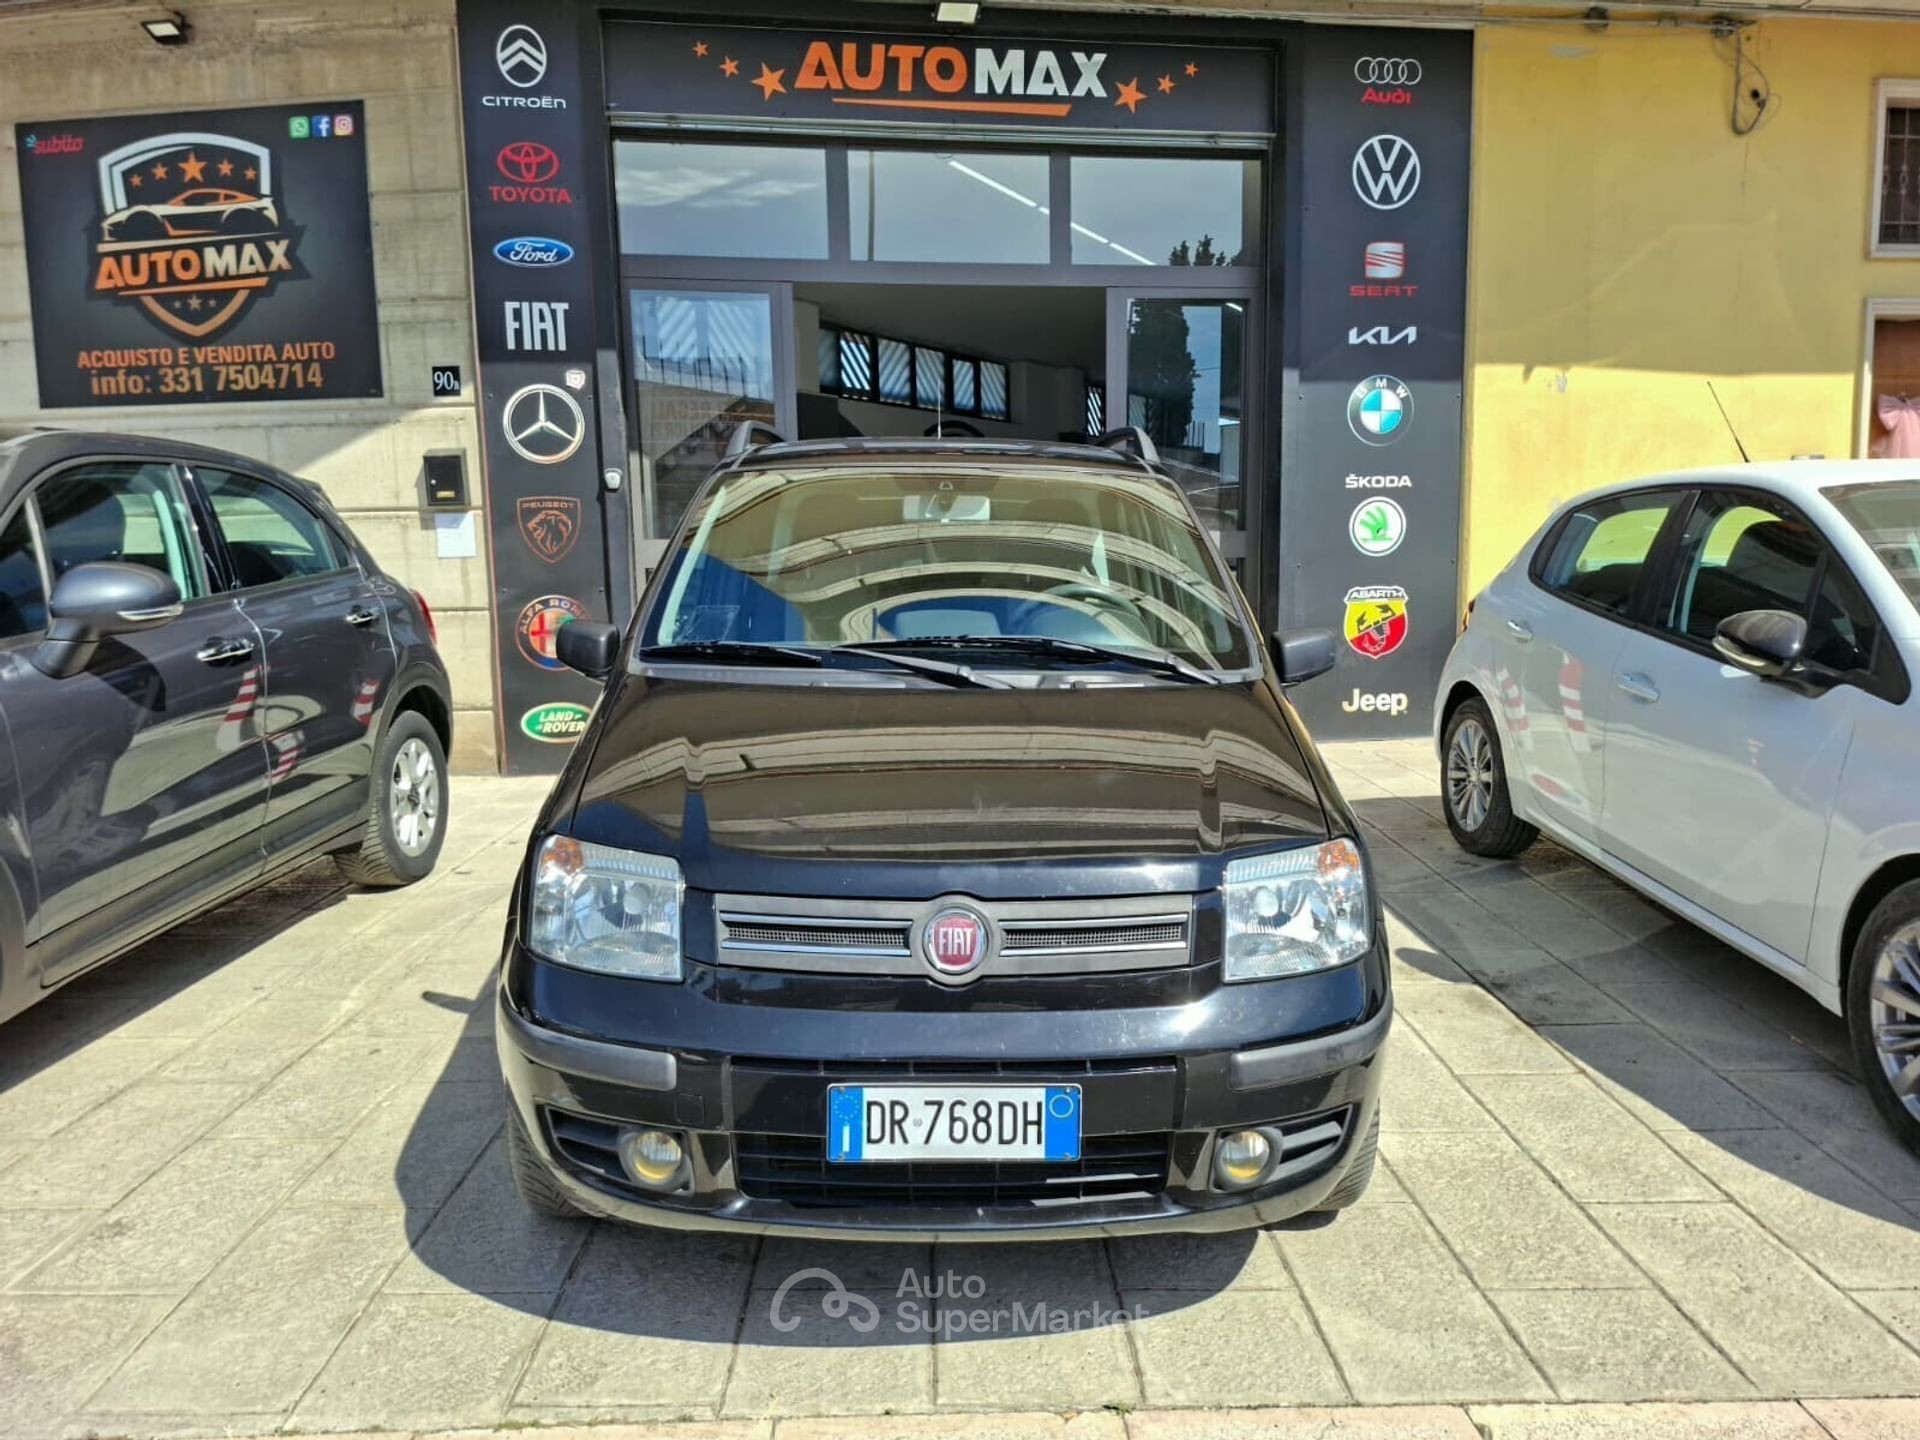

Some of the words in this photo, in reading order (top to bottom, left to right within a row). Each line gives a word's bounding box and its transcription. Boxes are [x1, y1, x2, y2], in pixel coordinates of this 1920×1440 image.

[794, 41, 1108, 98] AUTOMAX
[482, 96, 567, 109] CITROËN
[1361, 88, 1413, 104] Audi
[489, 186, 572, 204] TOYOTA
[510, 242, 558, 264] Ford
[95, 239, 293, 290] AUTOMAX
[1350, 285, 1417, 297] SEAT
[504, 301, 569, 351] FIAT
[1348, 326, 1417, 345] KIA
[77, 350, 173, 368] ACQUISTO
[178, 350, 190, 365] E
[194, 345, 278, 364] VENDITA
[282, 342, 335, 360] AUTO
[91, 371, 152, 395] info:
[158, 368, 204, 393] 331
[212, 362, 323, 391] 7504714
[1345, 473, 1412, 489] ŠKODA
[1350, 590, 1403, 599] ABARTH
[519, 603, 545, 635] ALFA
[1342, 689, 1408, 716] Jeep
[539, 711, 574, 723] LAND
[939, 927, 974, 955] FIAT
